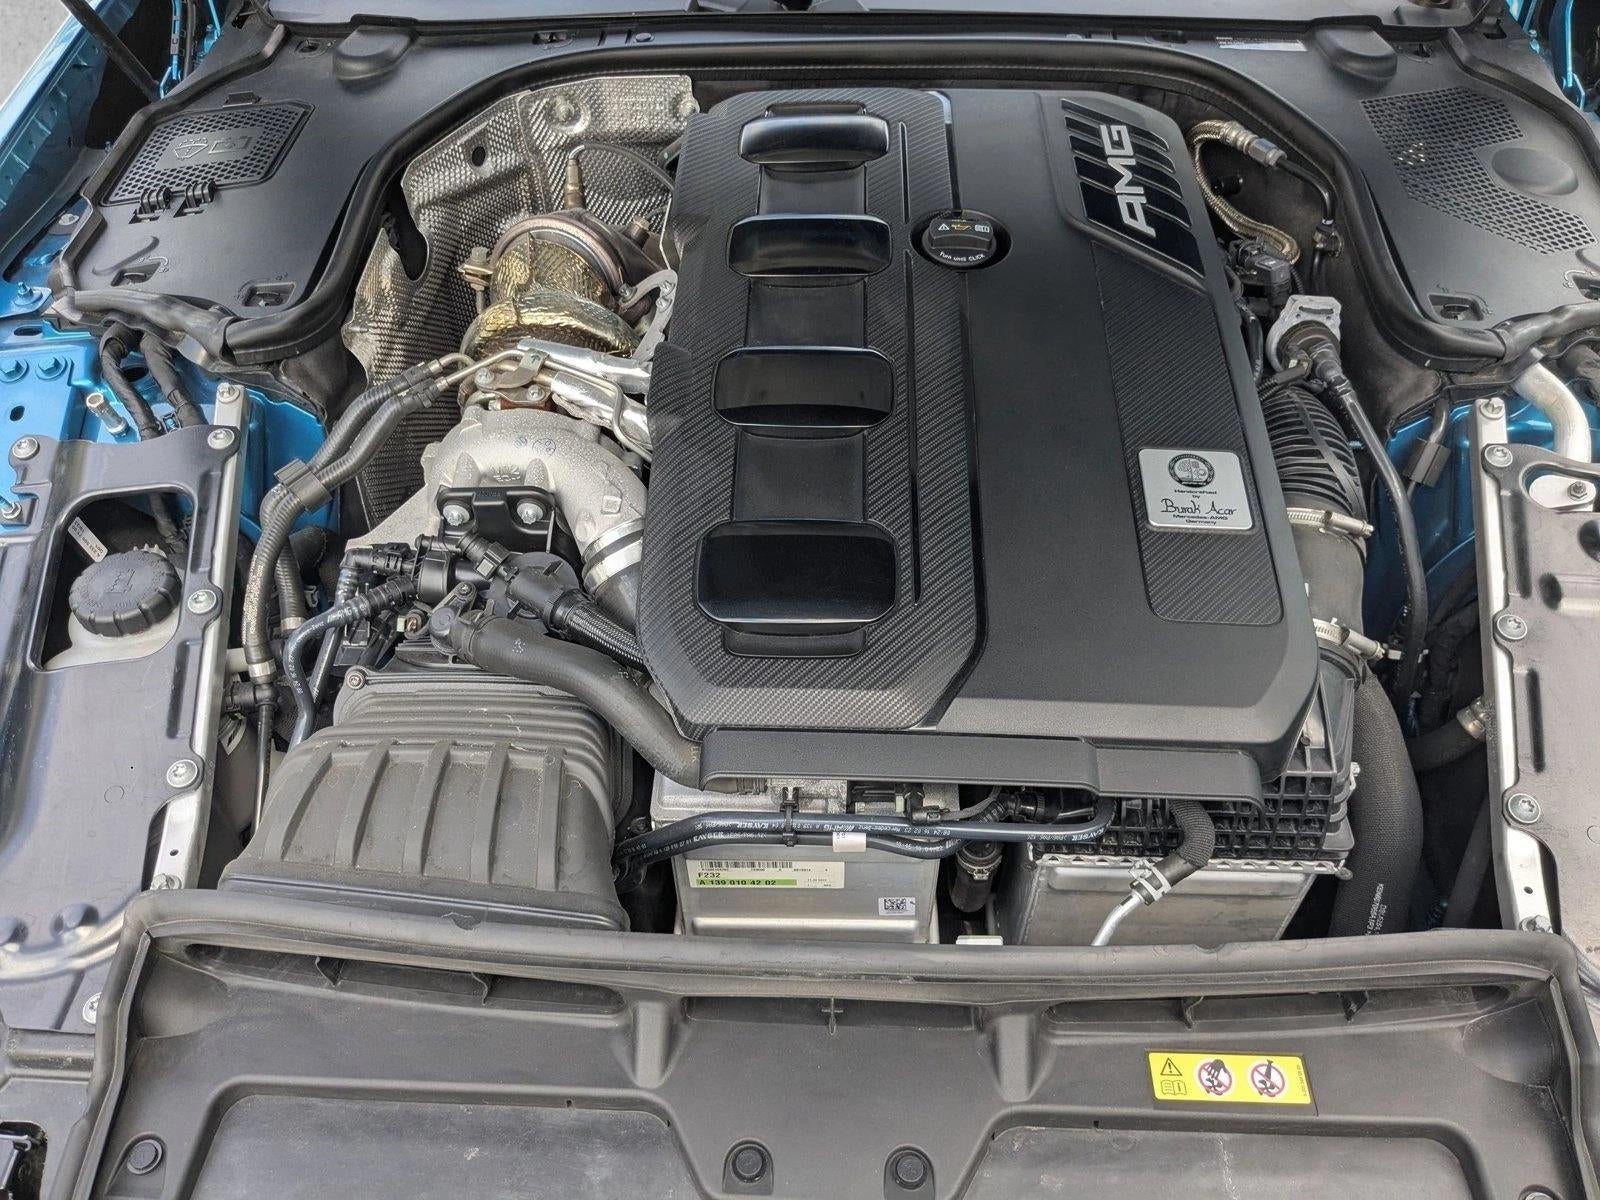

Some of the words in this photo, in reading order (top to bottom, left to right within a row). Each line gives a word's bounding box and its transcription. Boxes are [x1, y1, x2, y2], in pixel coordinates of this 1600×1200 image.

[1099, 124, 1156, 238] AMG
[939, 251, 952, 260] Turn
[968, 253, 985, 261] CLICK
[1205, 500, 1237, 516] Acar
[736, 821, 769, 829] KAYSER
[1072, 828, 1105, 842] KAYSER
